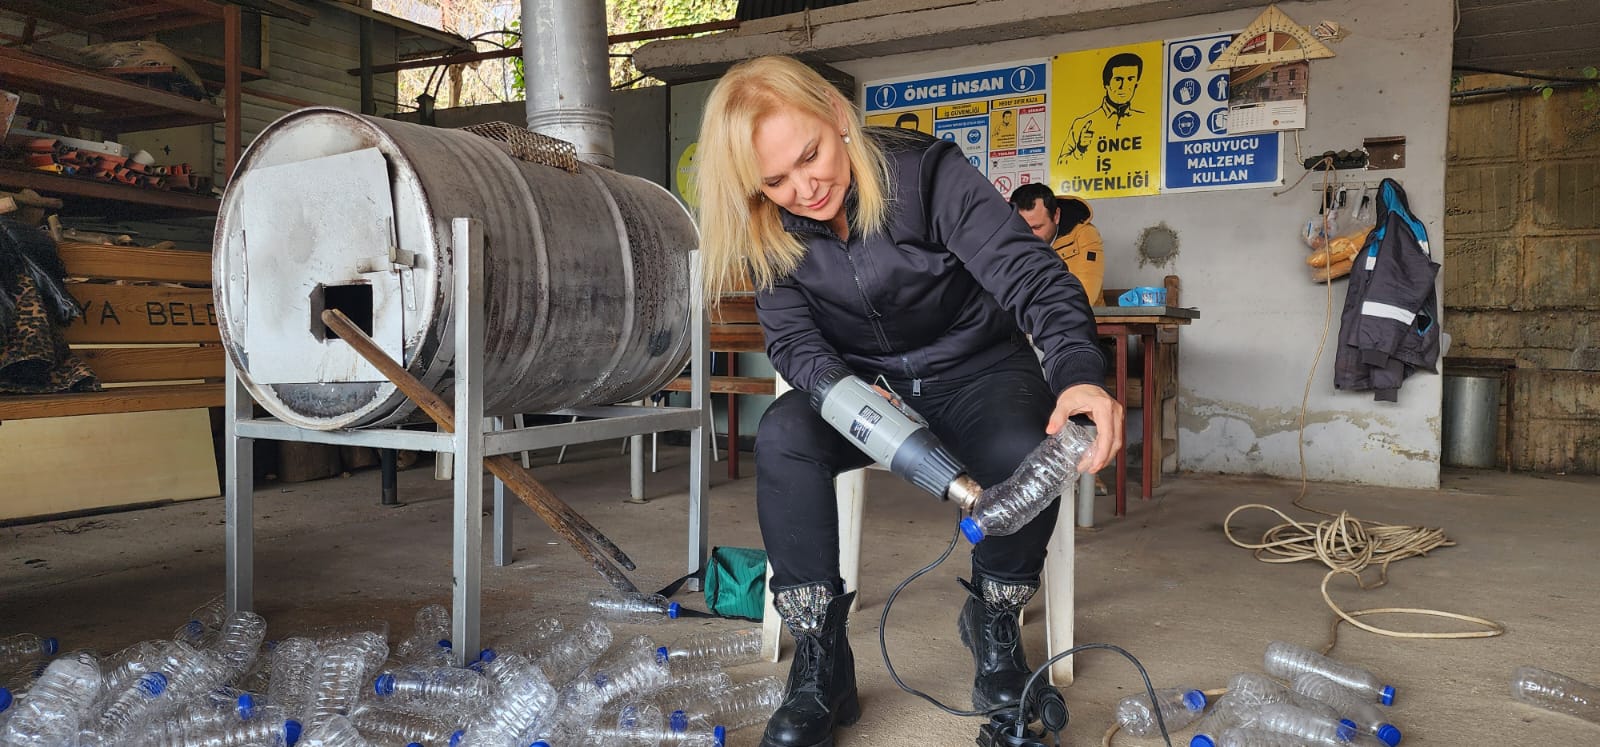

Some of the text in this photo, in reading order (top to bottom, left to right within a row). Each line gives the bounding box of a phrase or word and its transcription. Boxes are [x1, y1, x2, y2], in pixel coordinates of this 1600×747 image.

[904, 76, 1004, 102] ÖNCE İNSAN
[951, 106, 980, 117] GÜVENLİĞİ
[1097, 135, 1142, 153] ÖNCE
[1184, 137, 1259, 155] KORUYUCU
[1096, 156, 1112, 175] İŞ
[1187, 154, 1254, 169] MALZEME
[1060, 171, 1149, 193] GÜVENLİĞİ
[1192, 169, 1248, 184] KULLAN
